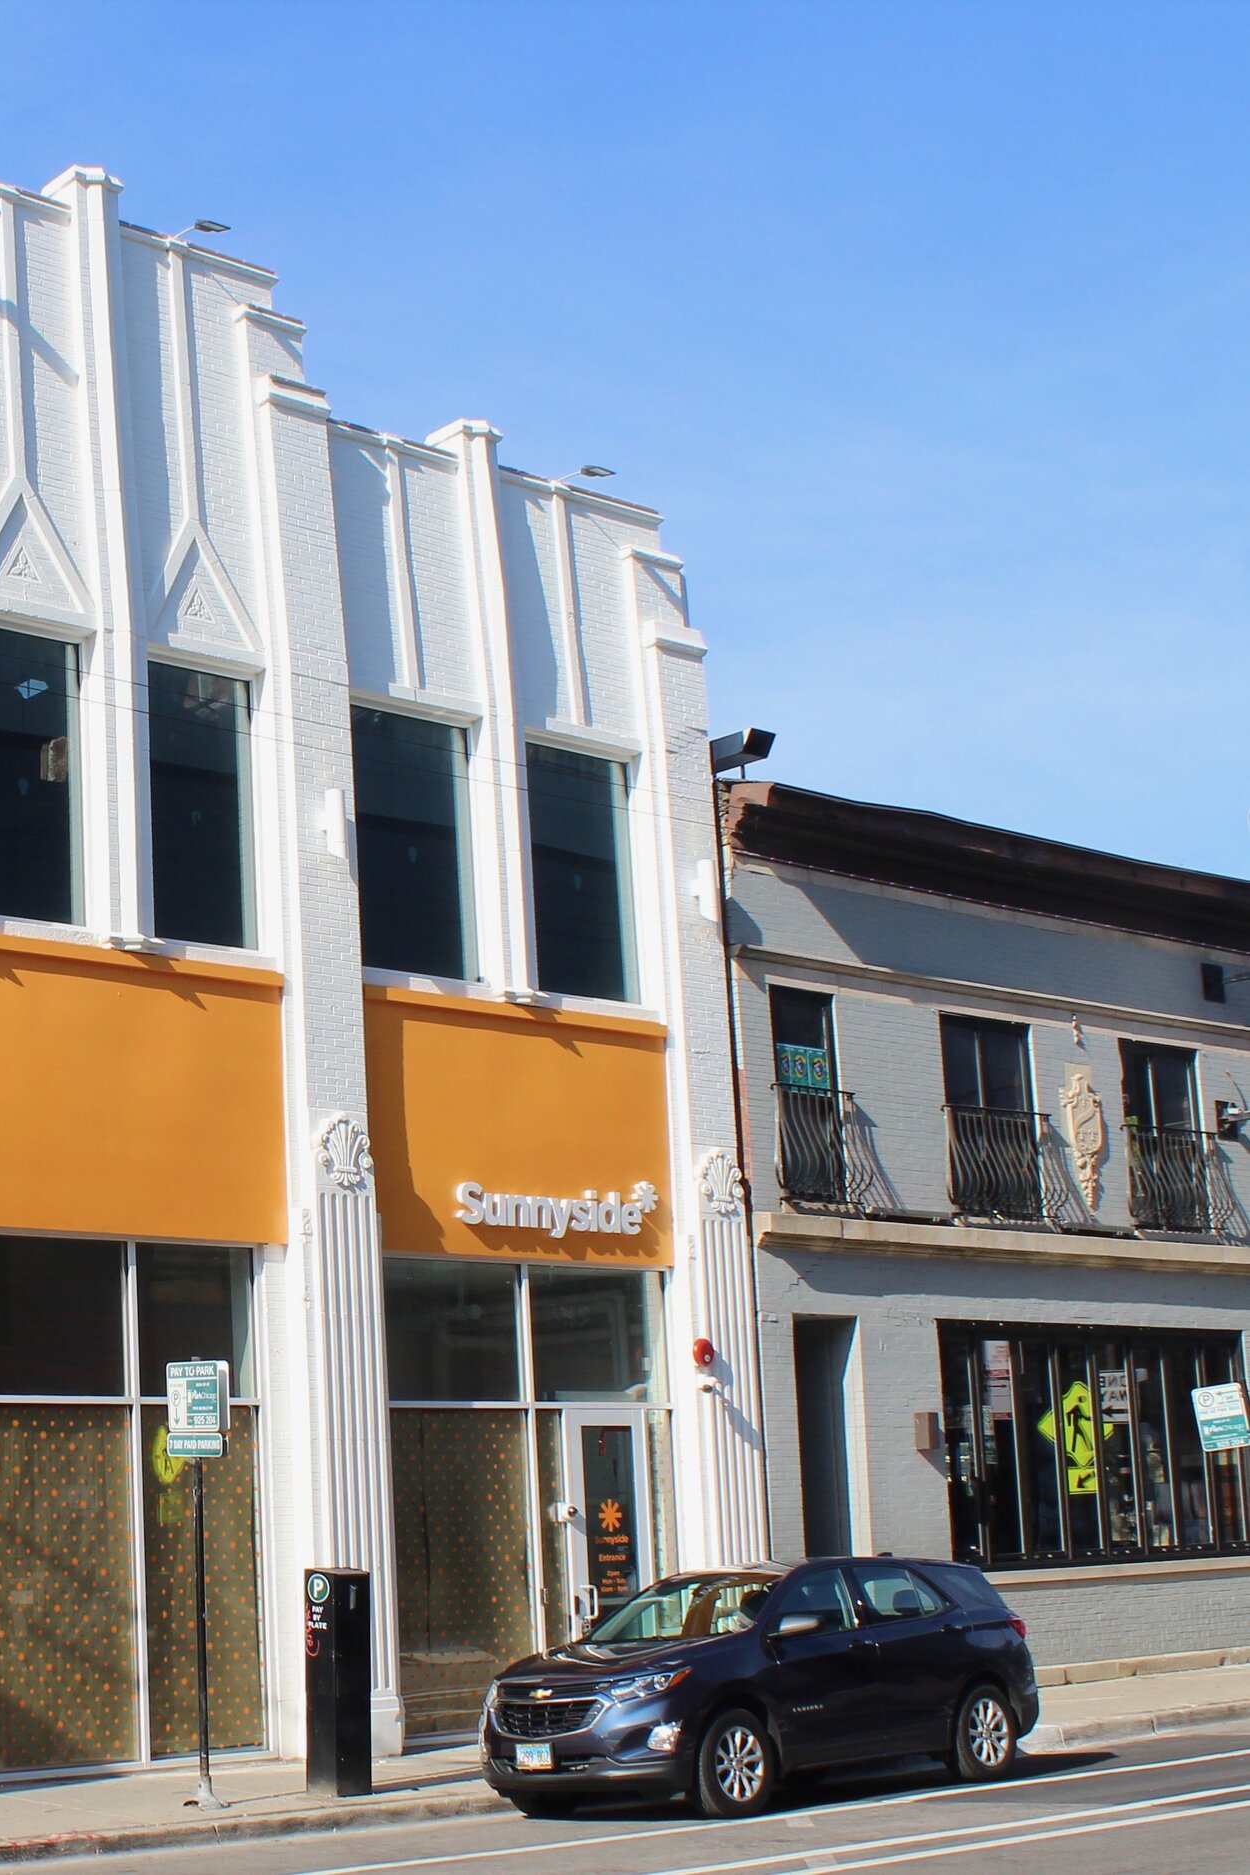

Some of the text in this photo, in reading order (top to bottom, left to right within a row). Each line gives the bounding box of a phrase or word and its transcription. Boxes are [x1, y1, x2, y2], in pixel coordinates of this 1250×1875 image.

[454, 1181, 643, 1239] Sunnyside
[170, 1365, 215, 1377] PAY TO PARK
[173, 1439, 183, 1449] DAY
[184, 1439, 197, 1449] PAID
[197, 1439, 220, 1450] PARKING
[595, 1534, 629, 1545] Sunnyside
[313, 1578, 324, 1599] P
[311, 1605, 324, 1613] PAY
[312, 1614, 321, 1622] BY
[307, 1621, 328, 1630] PLATE
